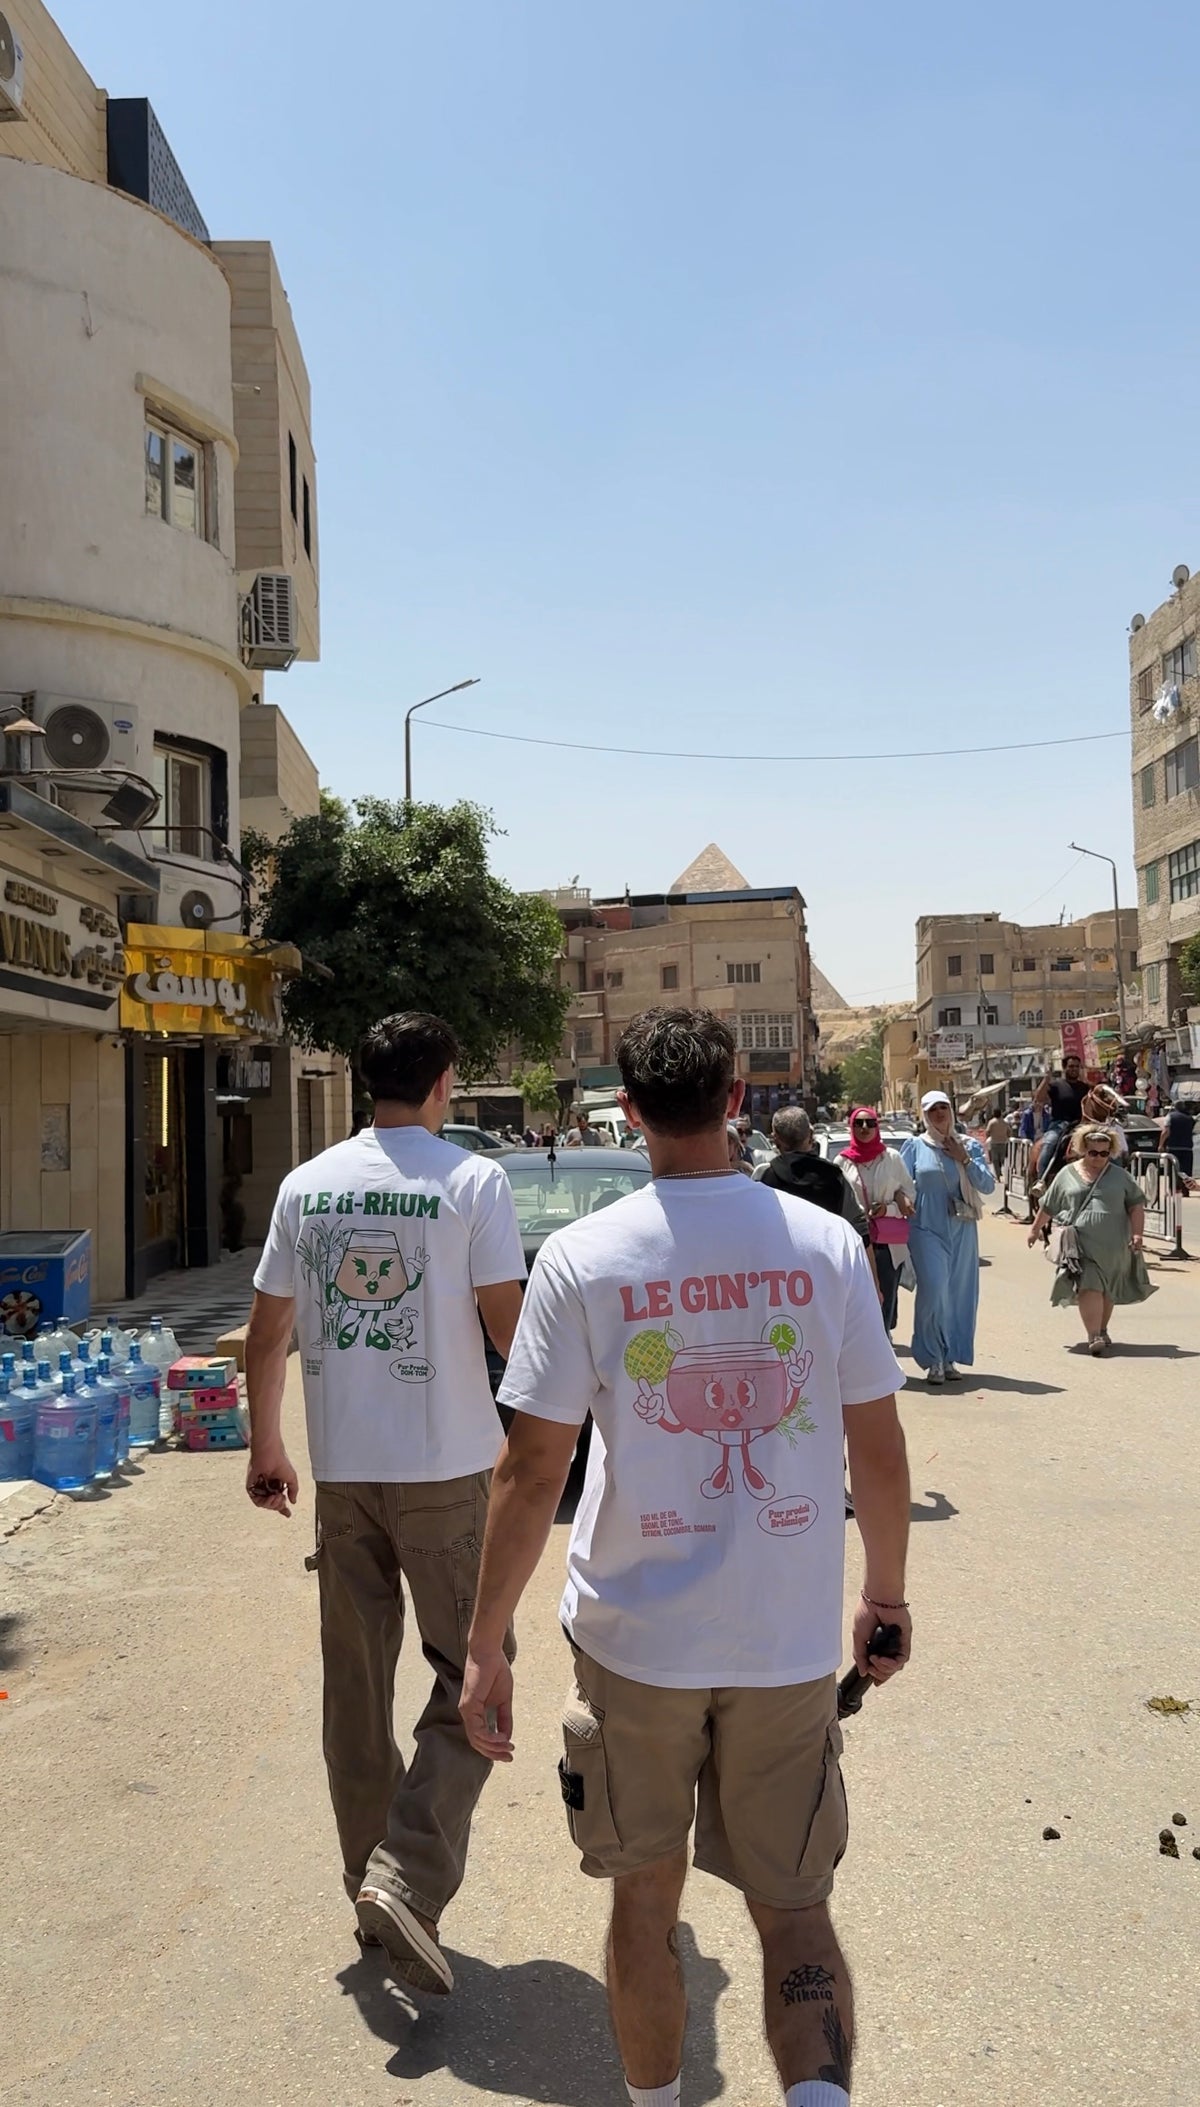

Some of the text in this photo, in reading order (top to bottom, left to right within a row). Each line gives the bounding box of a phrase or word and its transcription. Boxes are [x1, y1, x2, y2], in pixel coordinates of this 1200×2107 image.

[0, 910, 71, 977] VENUS
[127, 956, 248, 1026] يوسف
[302, 1191, 333, 1217] LE
[619, 1270, 813, 1322] LE GIN'TO
[660, 1511, 667, 1520] DE
[660, 1520, 668, 1528] DE
[768, 1509, 785, 1519] Pur
